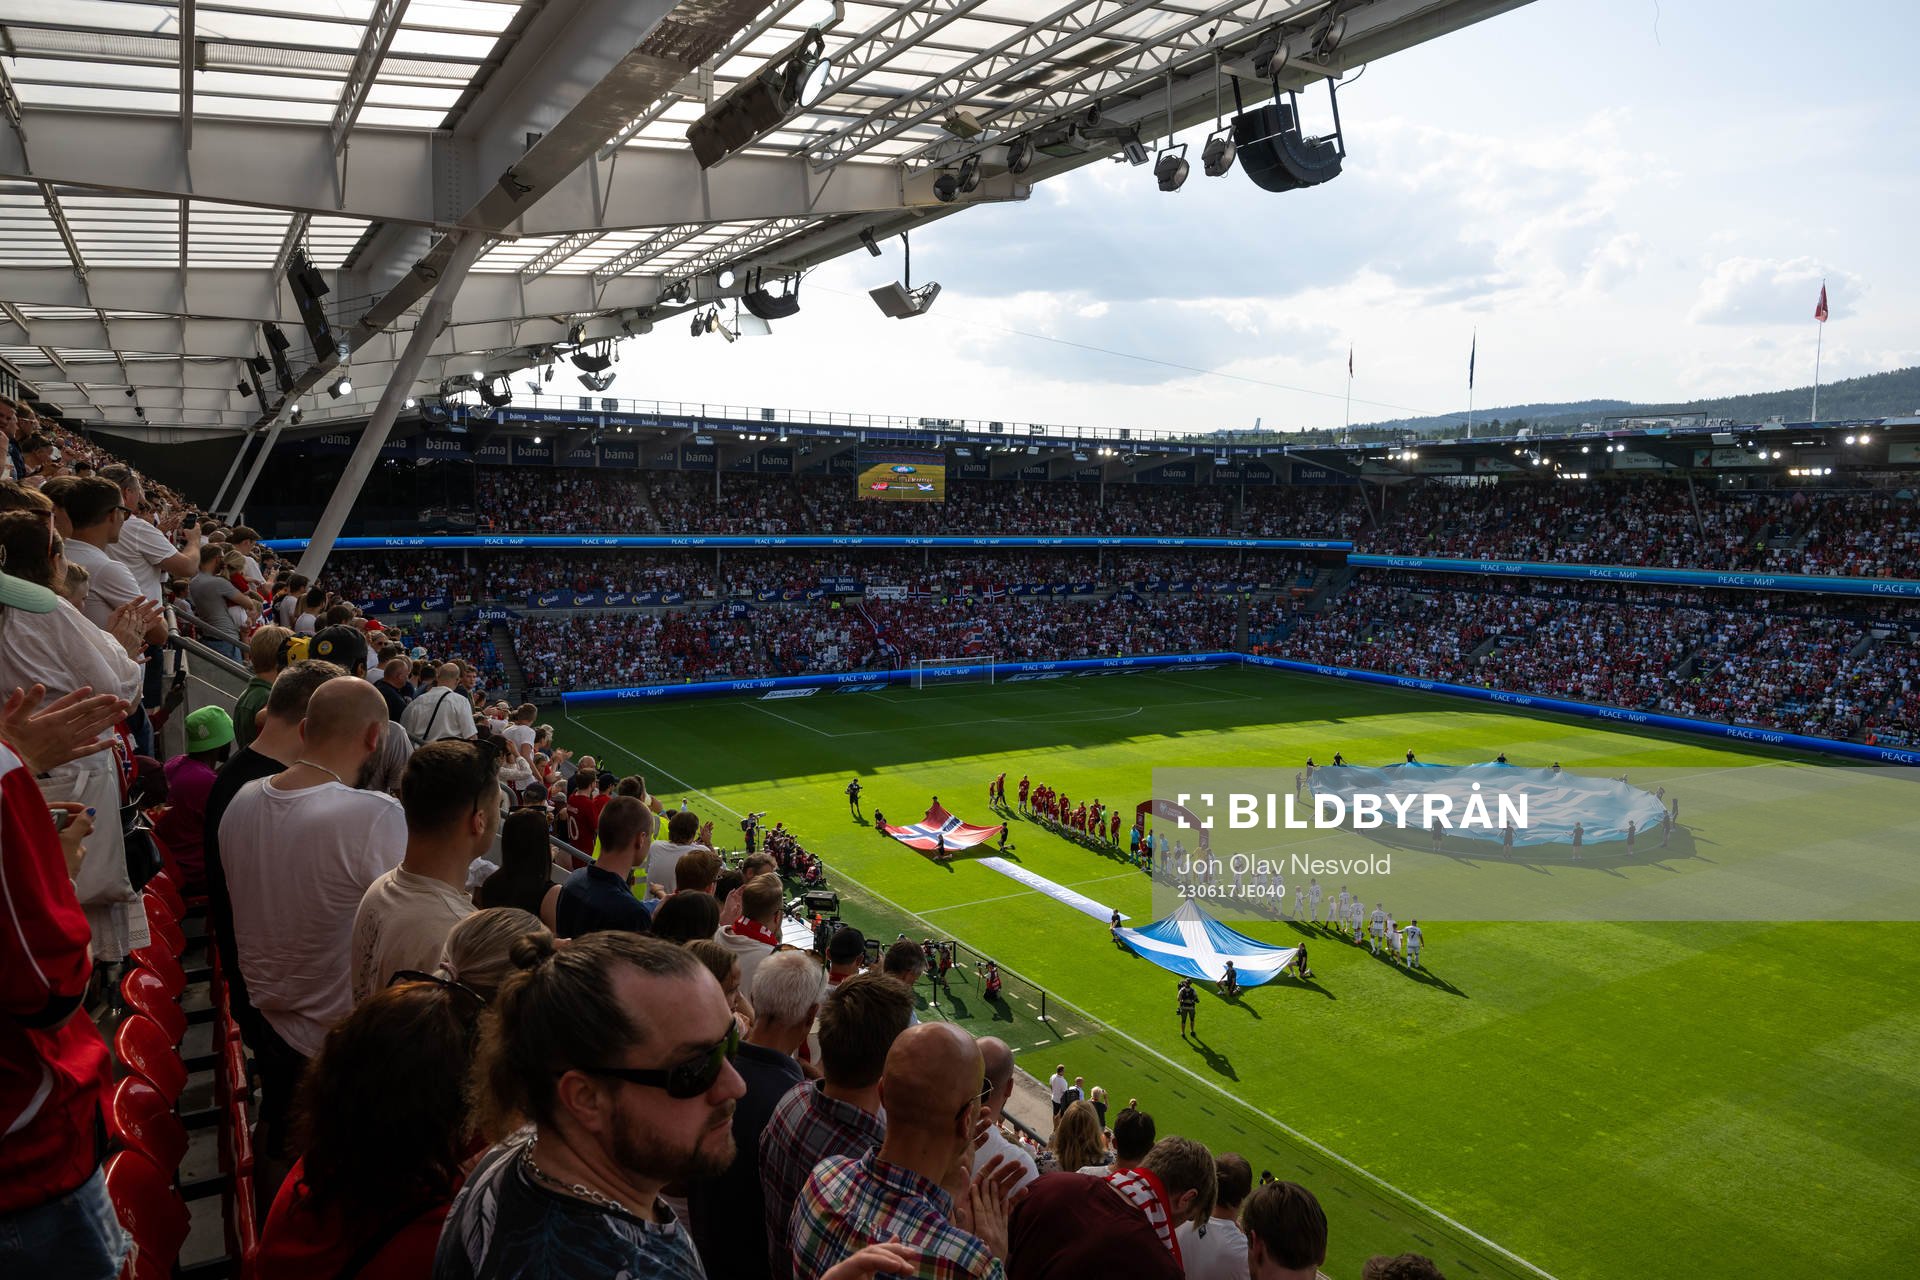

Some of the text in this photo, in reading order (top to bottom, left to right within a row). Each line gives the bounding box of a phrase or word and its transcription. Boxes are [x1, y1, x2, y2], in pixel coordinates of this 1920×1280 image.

[426, 437, 462, 451] bama
[517, 446, 550, 457] bama
[604, 448, 635, 460] bama
[686, 452, 714, 463] bama
[1480, 563, 1501, 572] PEACE
[1589, 569, 1612, 578] PEACE
[1718, 576, 1745, 585] PEACE
[1872, 583, 1905, 593] PEACE
[478, 609, 507, 619] bama
[733, 682, 754, 690] PEACE
[617, 690, 641, 699] PEACE
[1490, 693, 1510, 702] PEACE
[1599, 709, 1623, 719] PEACE
[1726, 728, 1784, 743] PEACE МИР
[1881, 751, 1913, 763] PEACE
